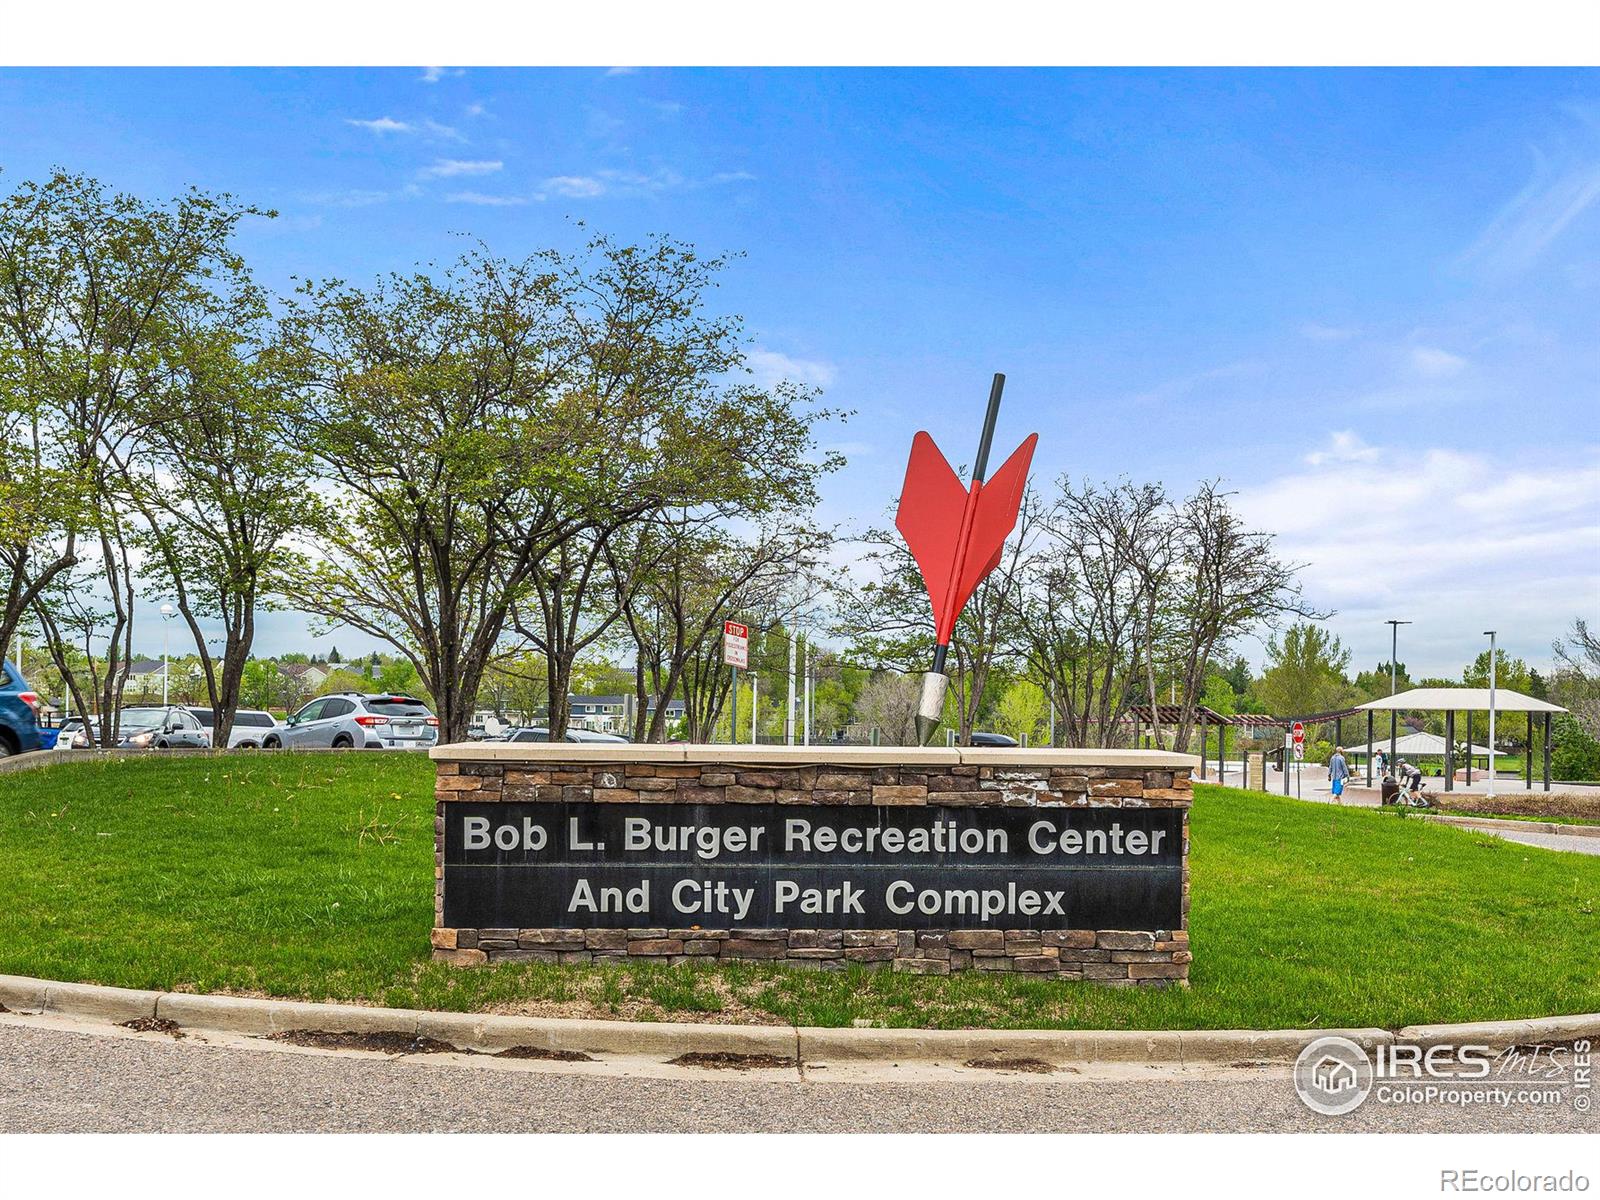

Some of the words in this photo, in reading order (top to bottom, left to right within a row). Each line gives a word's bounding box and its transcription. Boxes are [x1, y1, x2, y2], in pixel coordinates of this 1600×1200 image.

[728, 624, 745, 637] STOP
[463, 816, 548, 851] Bob
[569, 817, 605, 851] L.
[624, 817, 766, 860] Burger
[785, 818, 1008, 854] Recreation
[1028, 820, 1166, 855] Center
[567, 878, 650, 914] And
[671, 878, 755, 921] City
[775, 880, 866, 914] Park
[885, 879, 1066, 922] Complex
